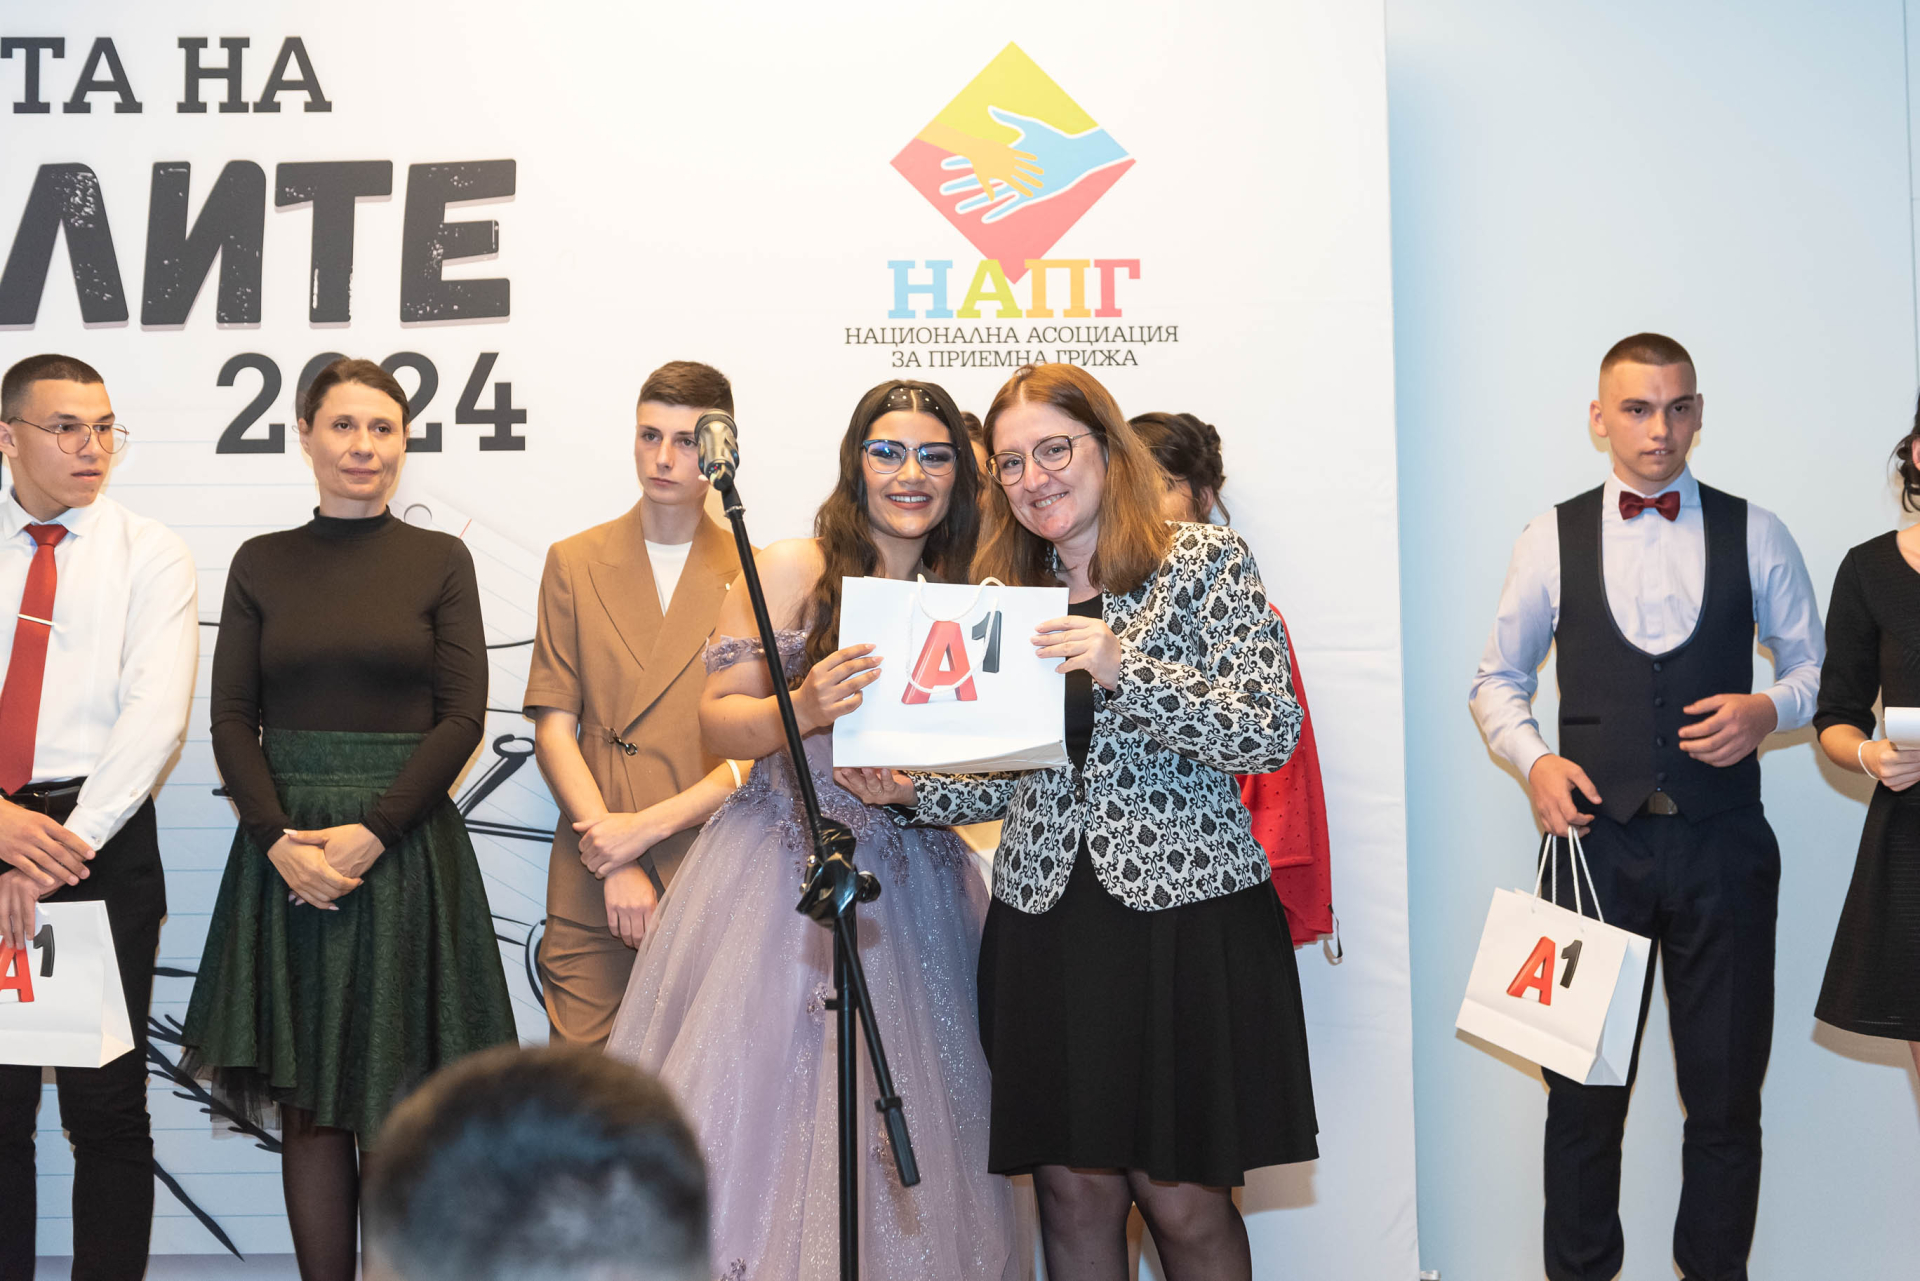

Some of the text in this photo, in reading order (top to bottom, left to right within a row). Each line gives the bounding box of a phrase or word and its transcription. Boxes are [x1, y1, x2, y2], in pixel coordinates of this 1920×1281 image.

[0, 36, 332, 114] ТА НА
[0, 159, 517, 328] ЛИТЕ
[887, 258, 1141, 320] НАПГ
[844, 325, 1180, 348] НАЦИОНАЛНА АСОЦИАЦИЯ
[892, 349, 1139, 368] ЗА ПРИЕМНА ГРИЖА
[901, 610, 1002, 705] A1
[1506, 936, 1583, 1006] A1
